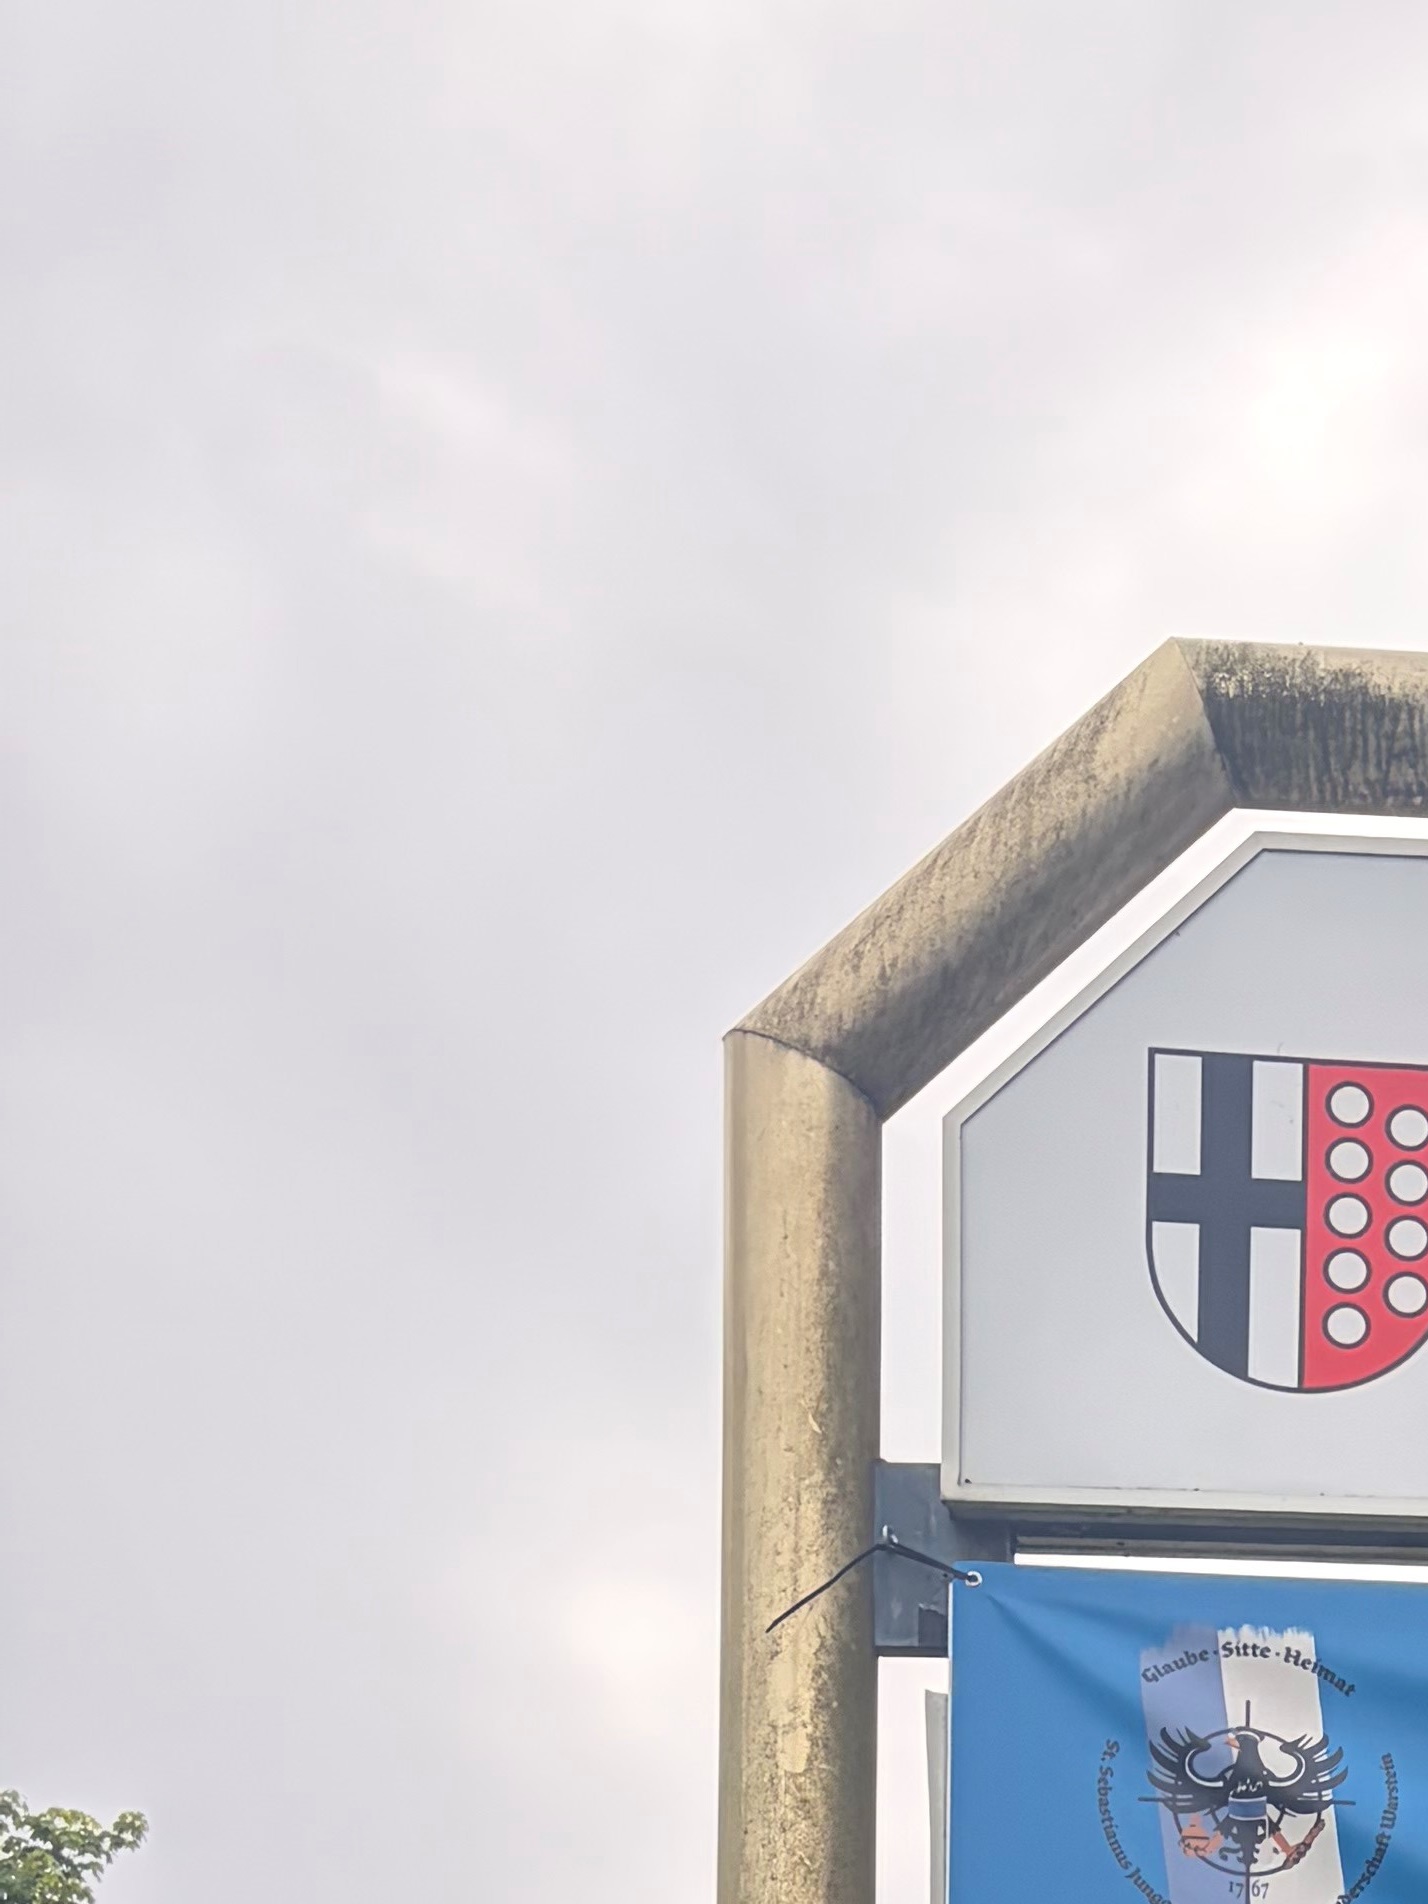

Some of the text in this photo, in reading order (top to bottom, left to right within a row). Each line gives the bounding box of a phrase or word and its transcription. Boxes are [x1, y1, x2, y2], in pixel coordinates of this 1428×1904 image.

[1141, 1640, 1356, 1698] Glaube Sitte Heimat
